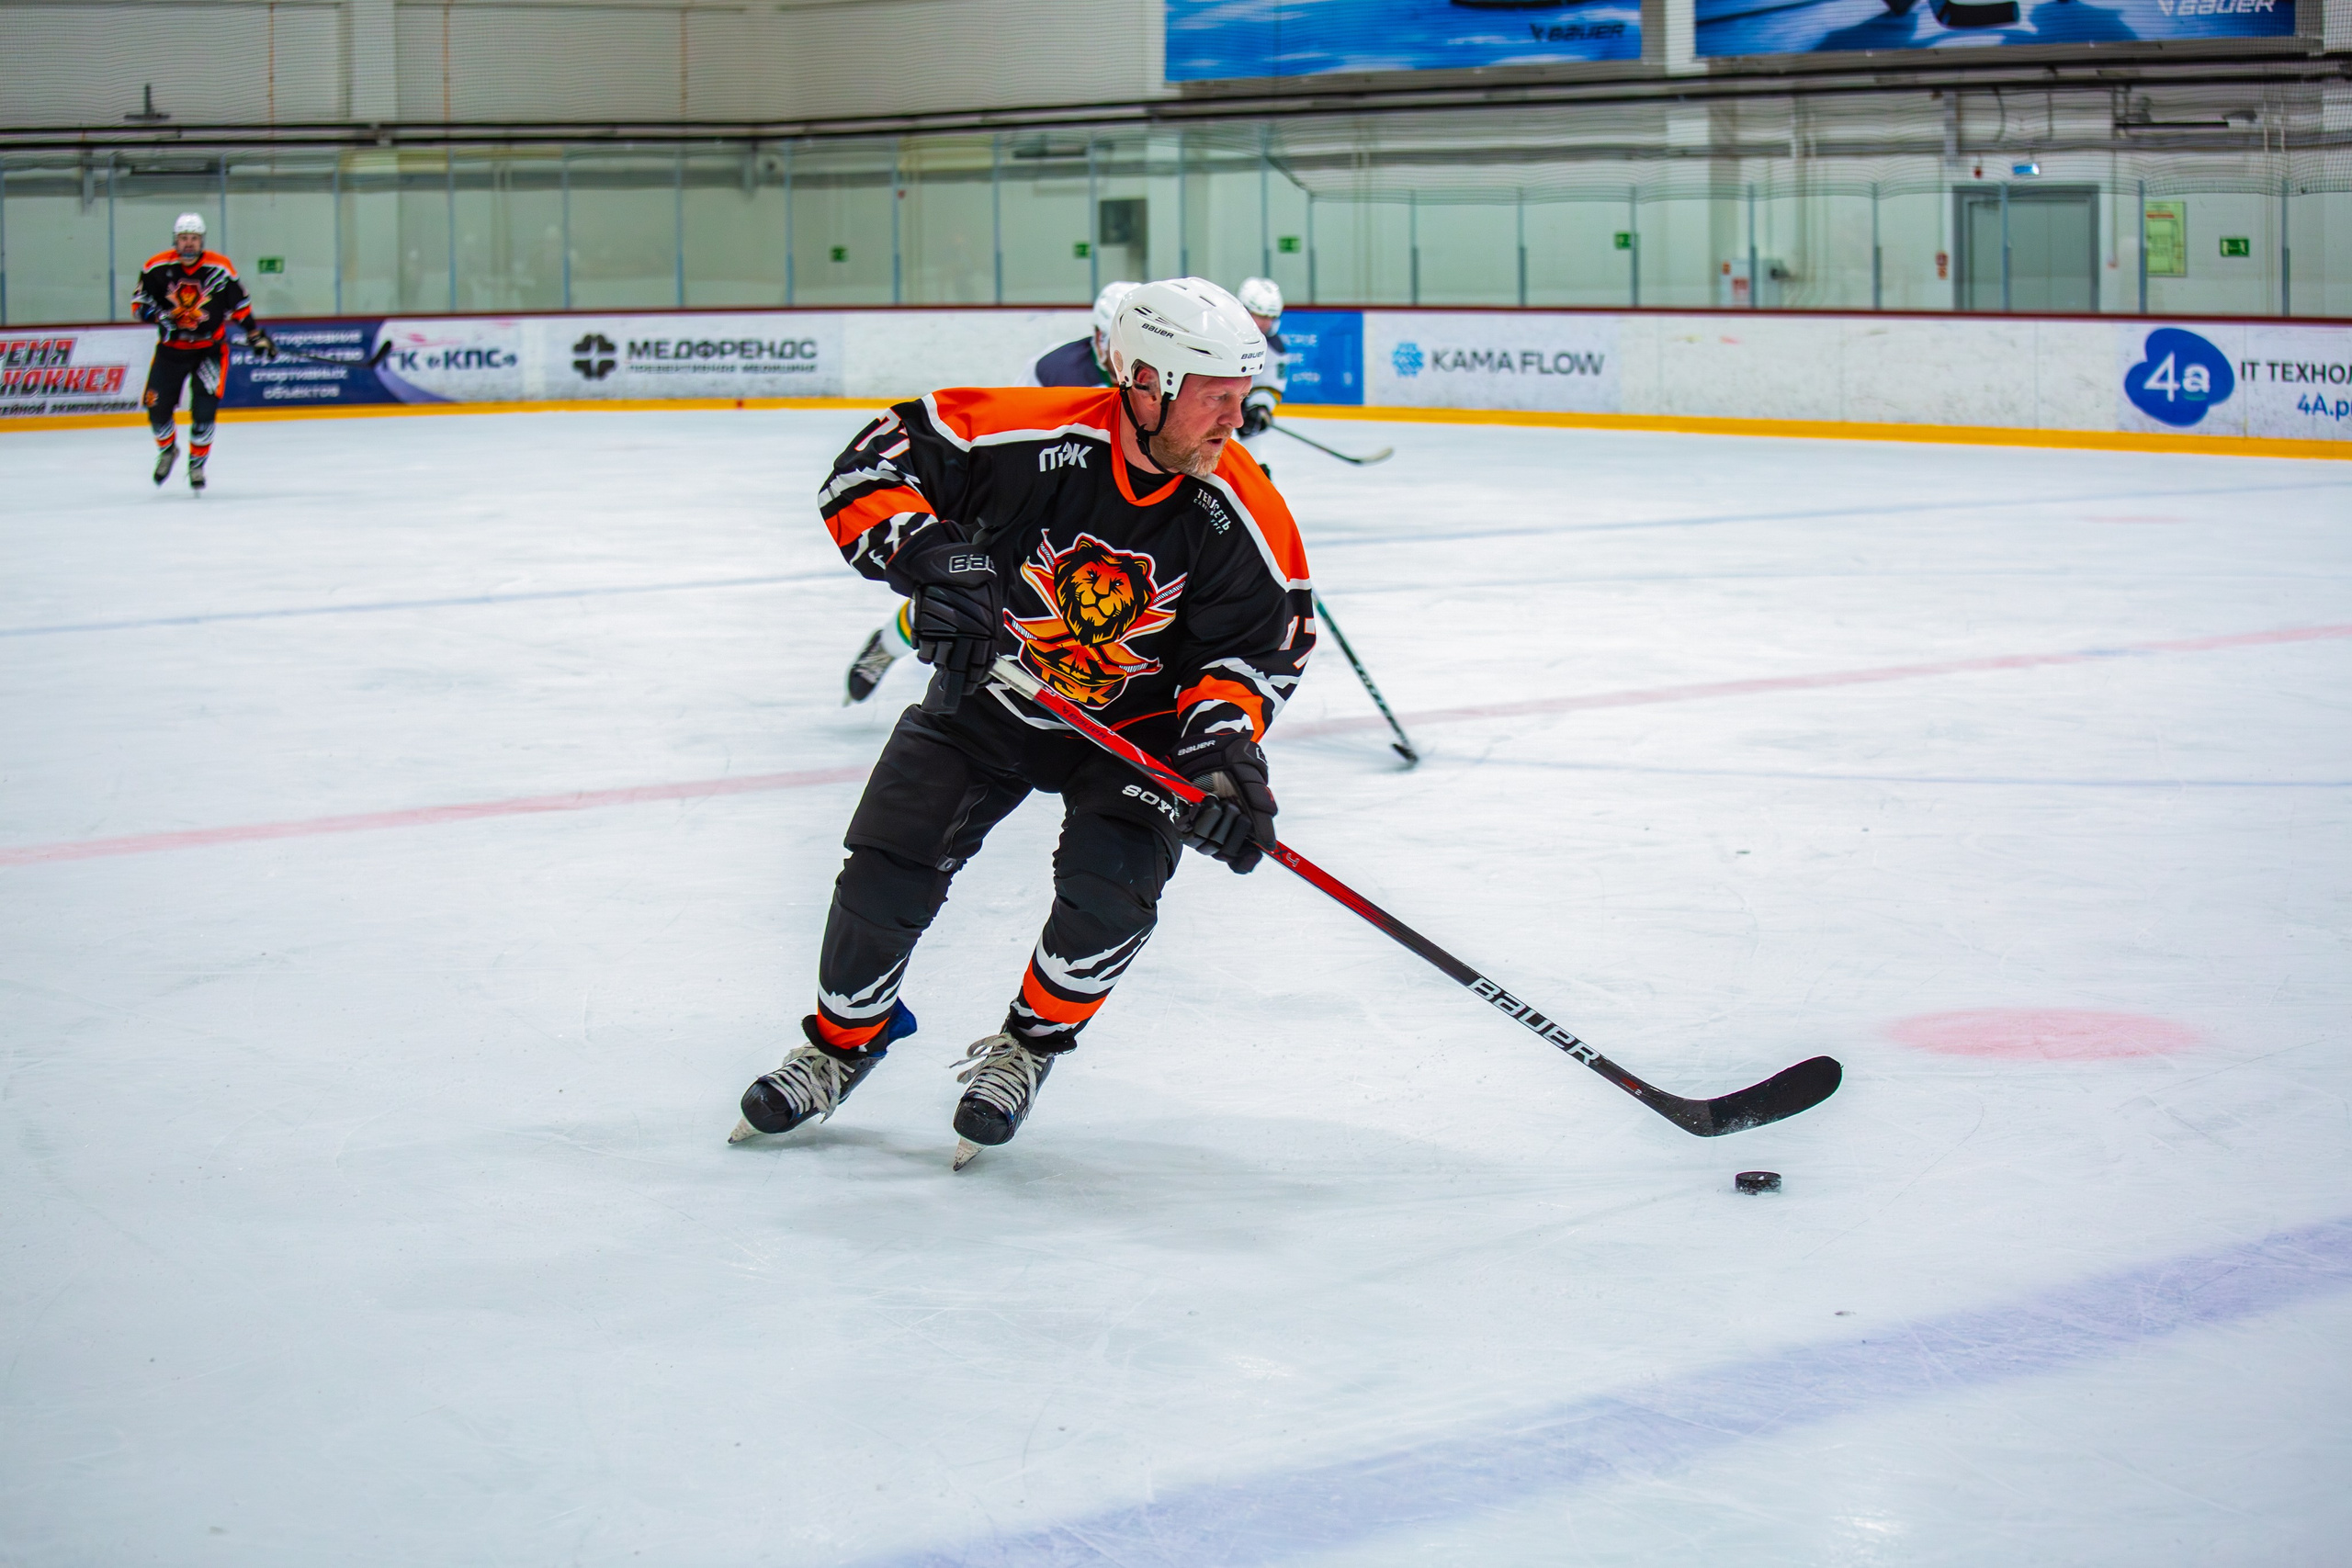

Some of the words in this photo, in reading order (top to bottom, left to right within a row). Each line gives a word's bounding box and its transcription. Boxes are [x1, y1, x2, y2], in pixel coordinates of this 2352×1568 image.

[1141, 322, 1174, 339] BAUER
[628, 340, 818, 359] МЕДФРЕНДС
[1430, 349, 1516, 374] KAMA
[1520, 350, 1606, 376] FLOW
[2297, 392, 2352, 422] 4А.р
[1178, 739, 1216, 756] BAUER
[1468, 977, 1600, 1066] BAUER
